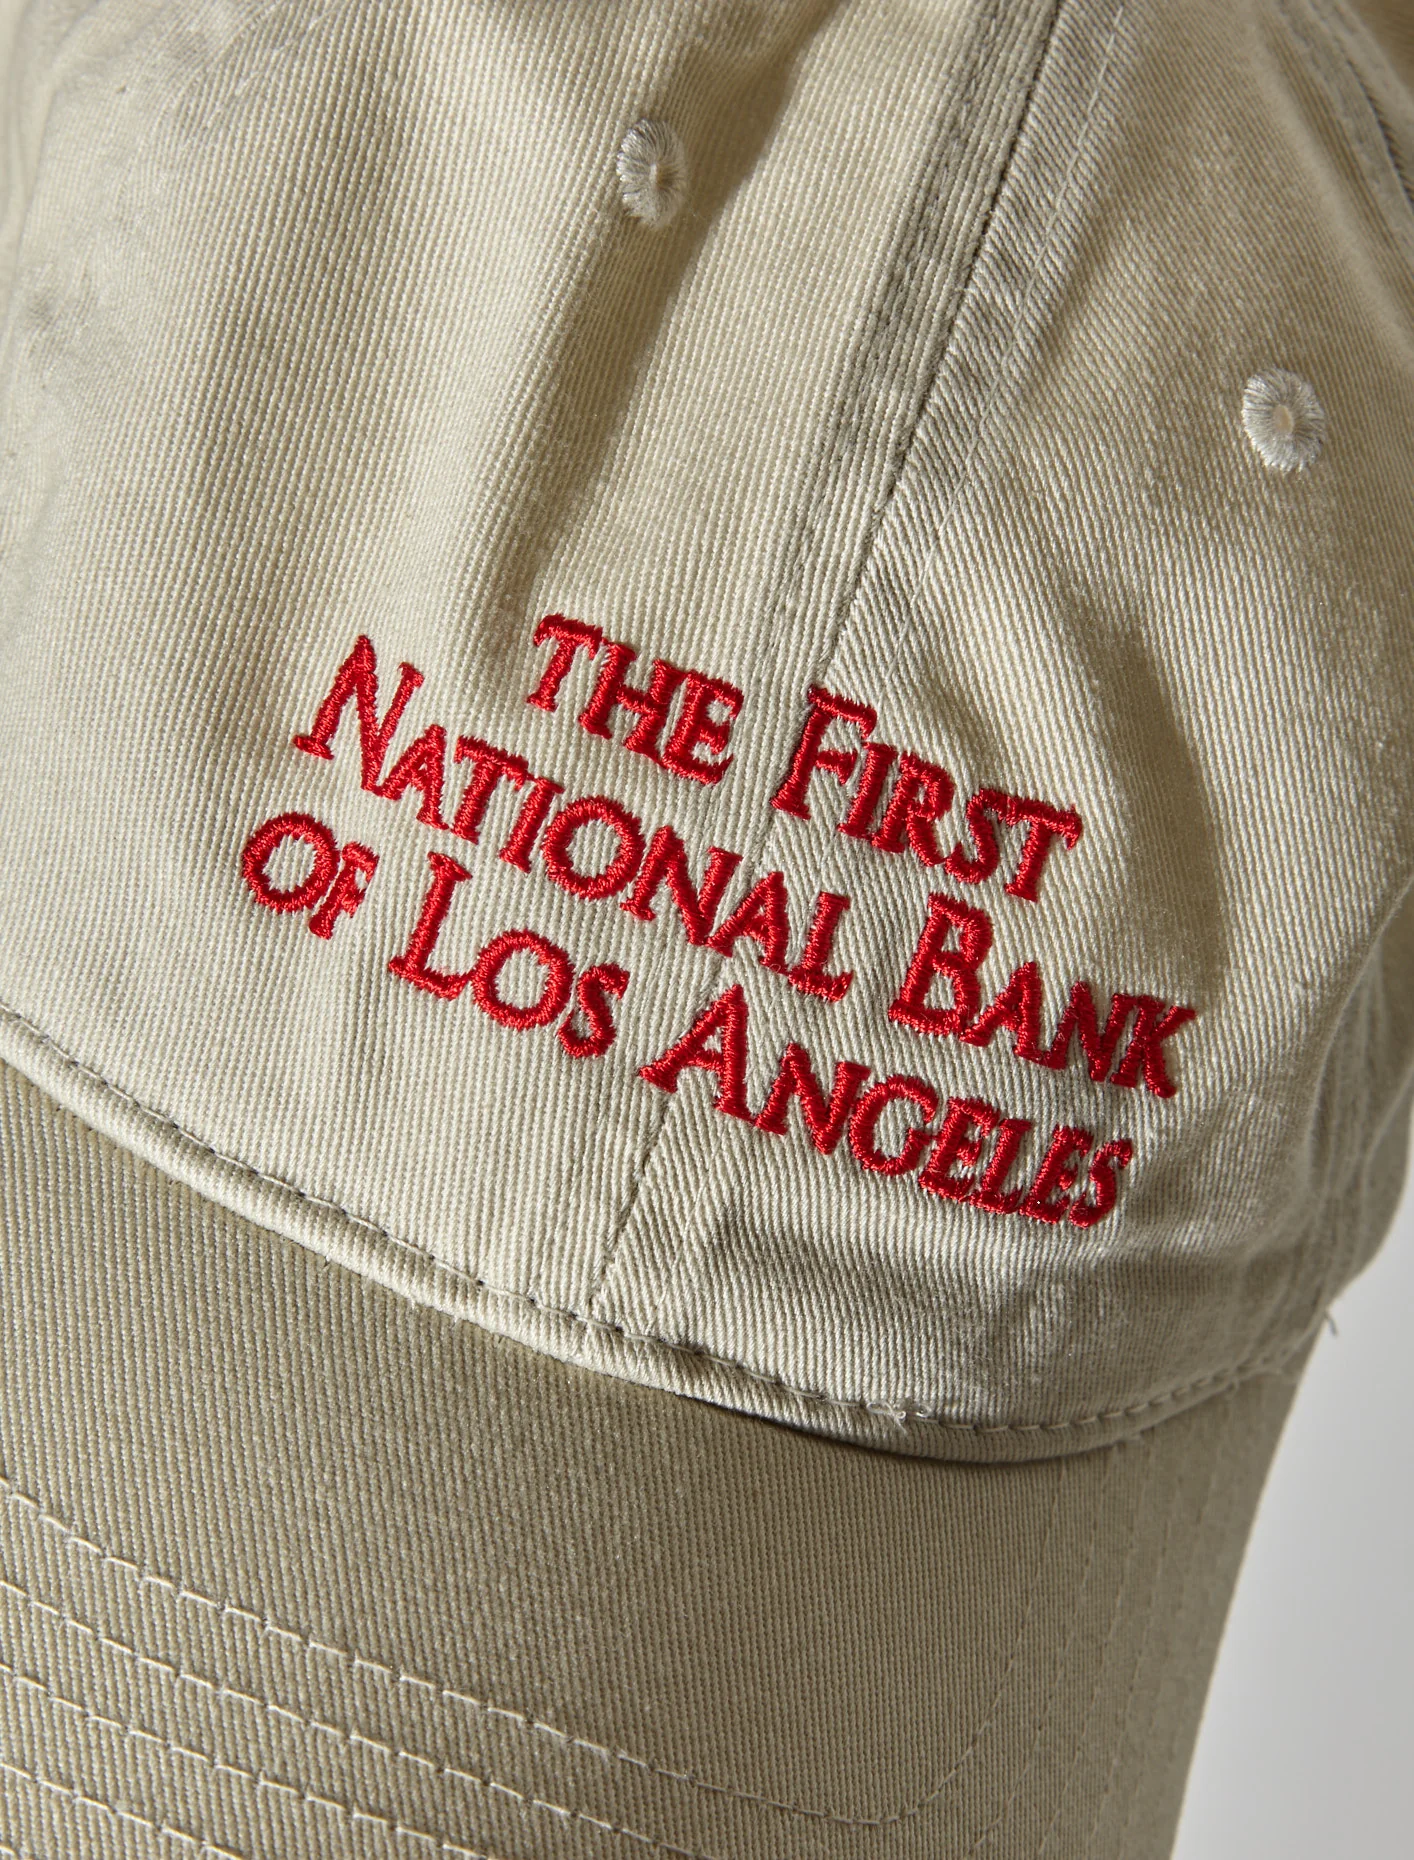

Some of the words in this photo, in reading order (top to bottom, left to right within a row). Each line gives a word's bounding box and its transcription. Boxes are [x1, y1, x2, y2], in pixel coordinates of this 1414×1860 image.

[292, 635, 853, 1003] NATIONAL
[888, 893, 1196, 1098] BANK
[526, 614, 744, 785] THE
[770, 686, 1082, 902] FIRST
[240, 811, 379, 940] OF
[387, 852, 629, 1059] LOS
[639, 984, 1133, 1229] ANGELES
